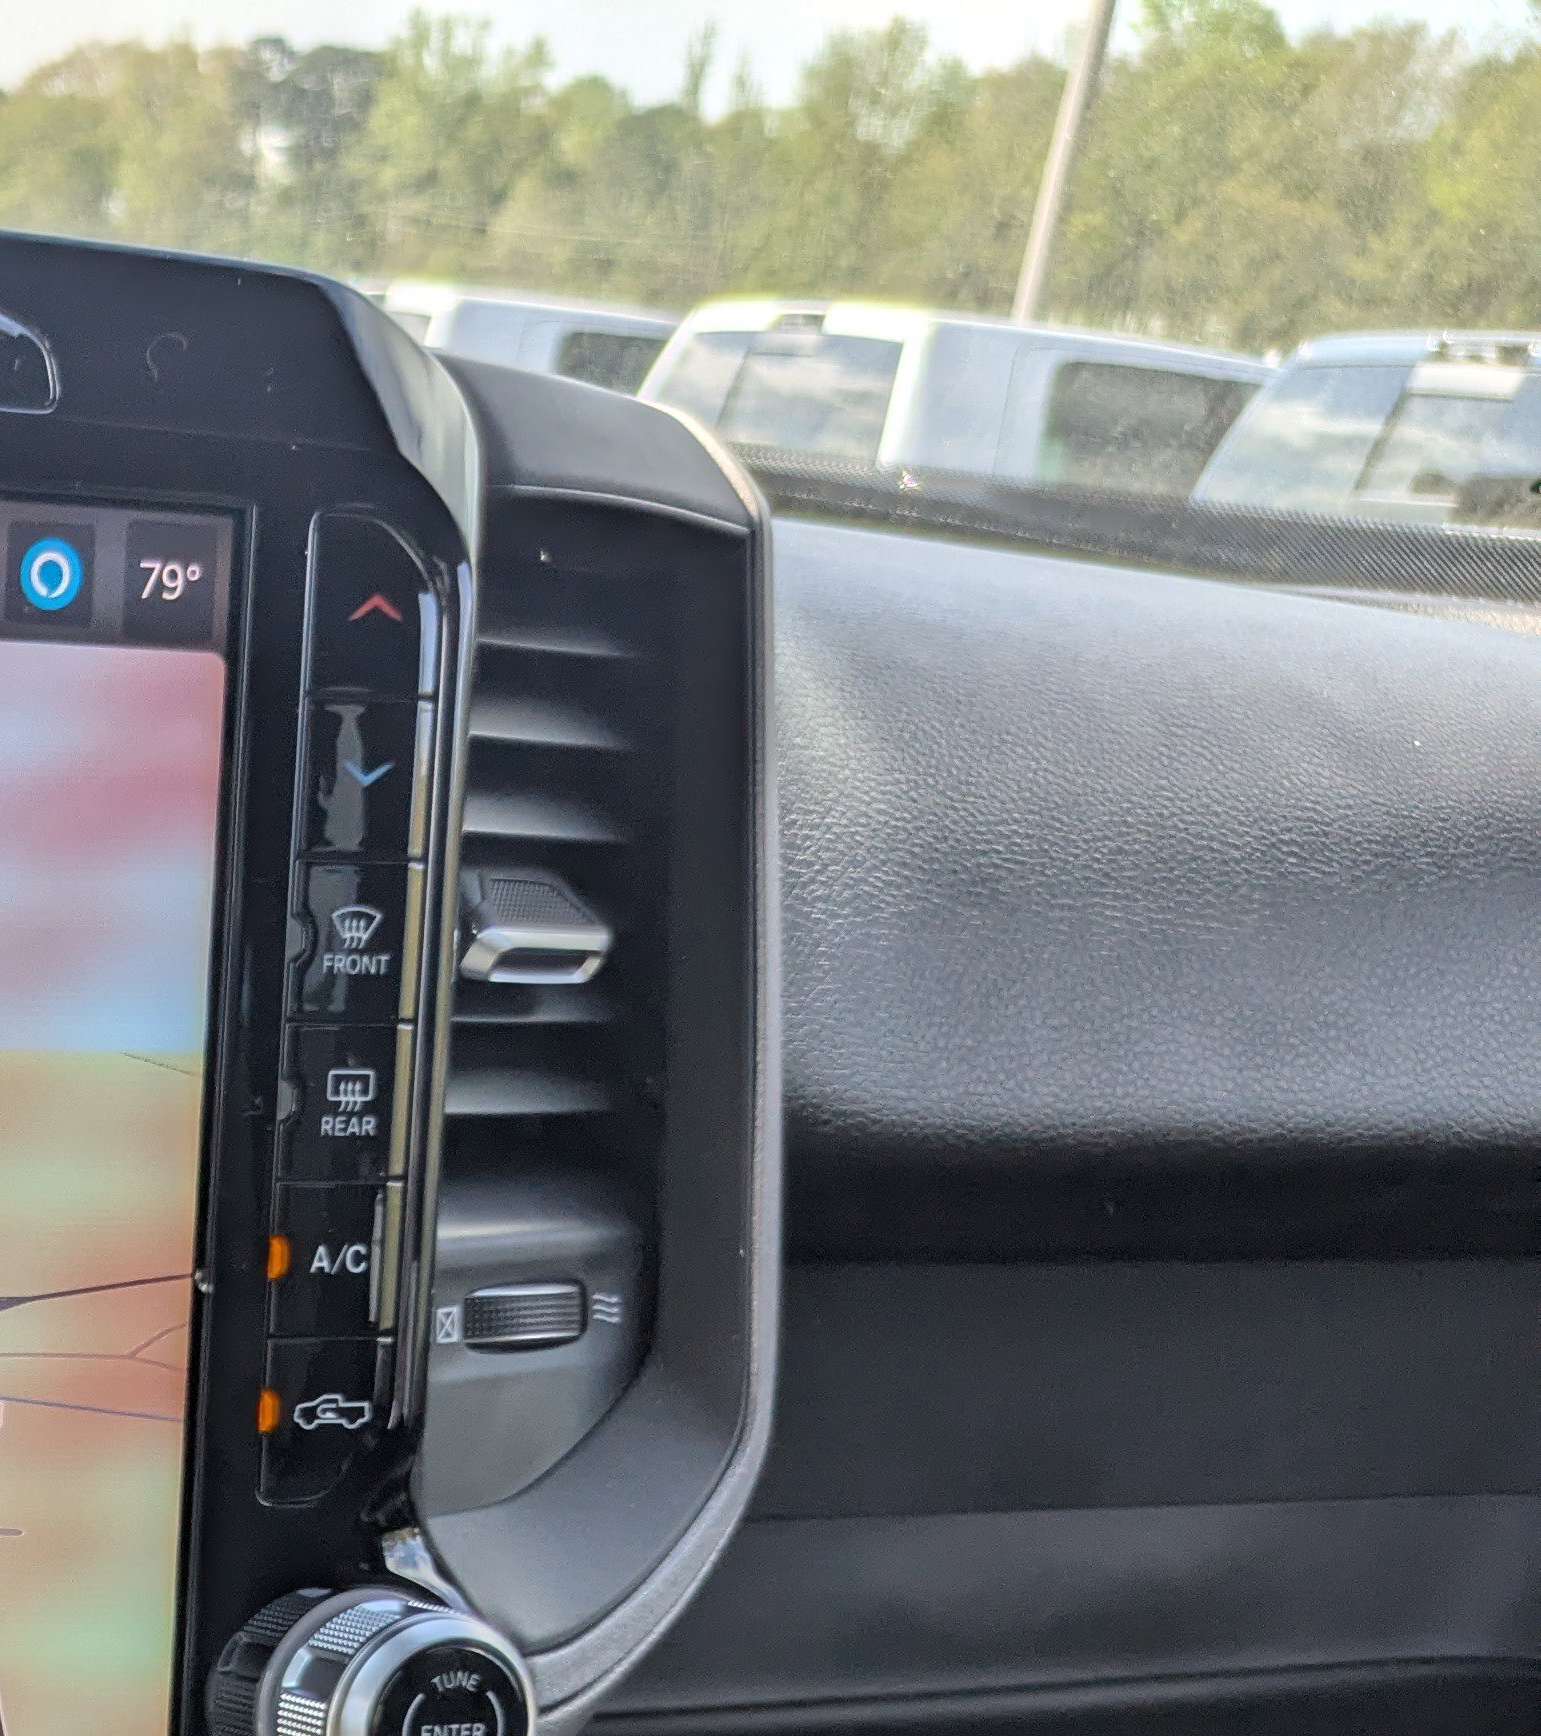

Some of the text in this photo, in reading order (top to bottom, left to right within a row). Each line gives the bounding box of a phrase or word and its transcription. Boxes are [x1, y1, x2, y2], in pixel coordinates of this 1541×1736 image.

[322, 954, 390, 976] FRONT
[320, 1116, 377, 1137] REAR
[309, 1244, 369, 1274] A/C
[431, 1671, 481, 1692] TUNE
